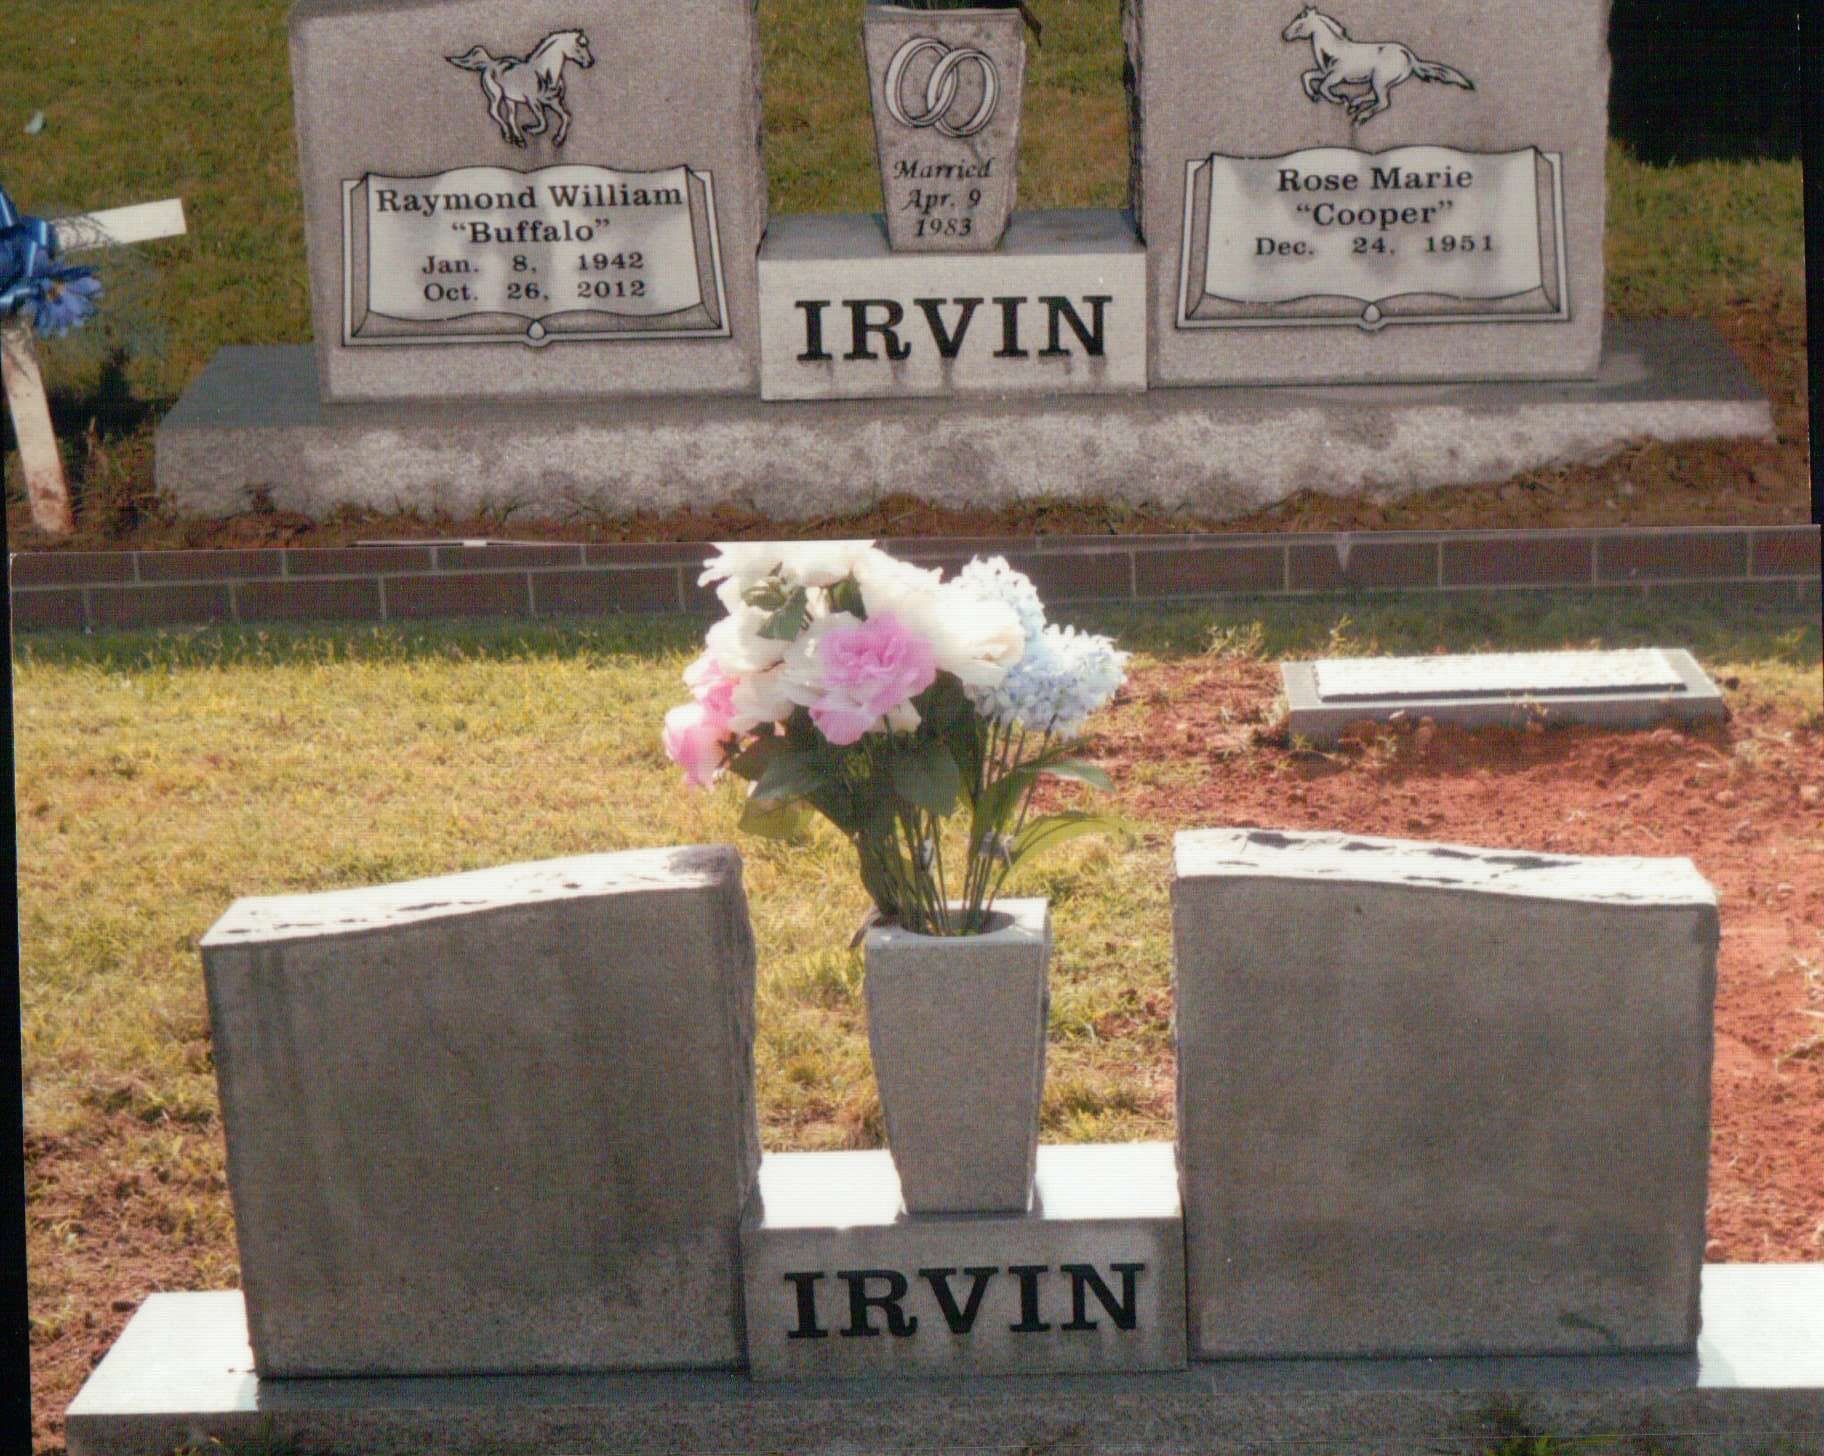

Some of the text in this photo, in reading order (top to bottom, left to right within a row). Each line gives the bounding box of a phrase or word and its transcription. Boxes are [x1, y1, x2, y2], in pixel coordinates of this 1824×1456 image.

[894, 158, 995, 179] Married
[1277, 165, 1473, 193] Rose Marie
[376, 184, 683, 217] Raymond William
[902, 188, 982, 214] Apr. 9
[916, 217, 972, 237] 1983
[1255, 237, 1315, 257] Dec.
[1424, 234, 1494, 253] 1951
[422, 255, 479, 275] Jan.
[577, 252, 645, 271] 1942
[424, 282, 479, 302] Oct.
[577, 280, 646, 299] 2012
[795, 295, 1113, 361] IRVIN
[784, 1263, 1145, 1339] IRVIN
